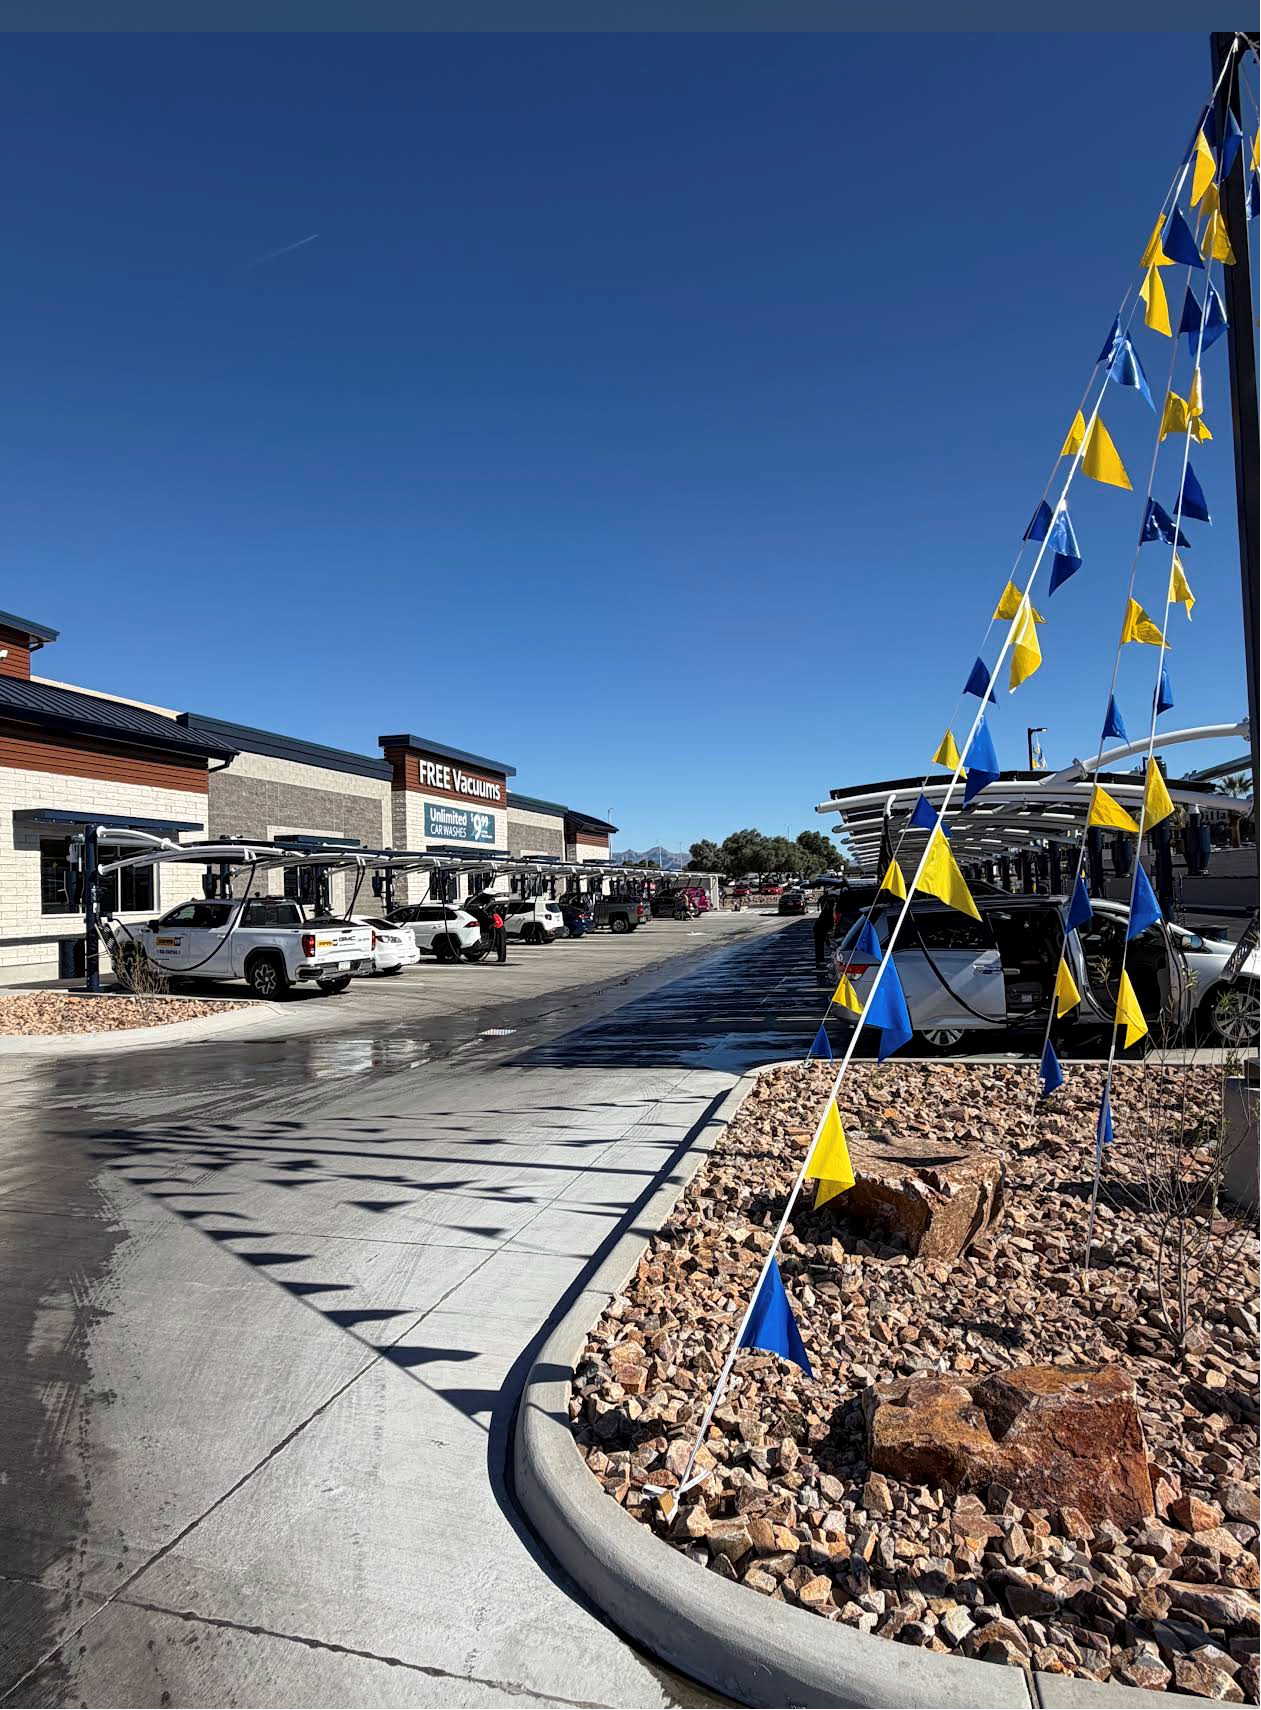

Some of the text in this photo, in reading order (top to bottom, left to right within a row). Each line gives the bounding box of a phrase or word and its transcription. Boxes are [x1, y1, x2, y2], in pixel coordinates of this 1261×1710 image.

[419, 759, 501, 801] FREE Vacuums
[430, 808, 467, 825] Unlimited
[430, 823, 443, 836] CAR
[443, 826, 467, 838] WASHES
